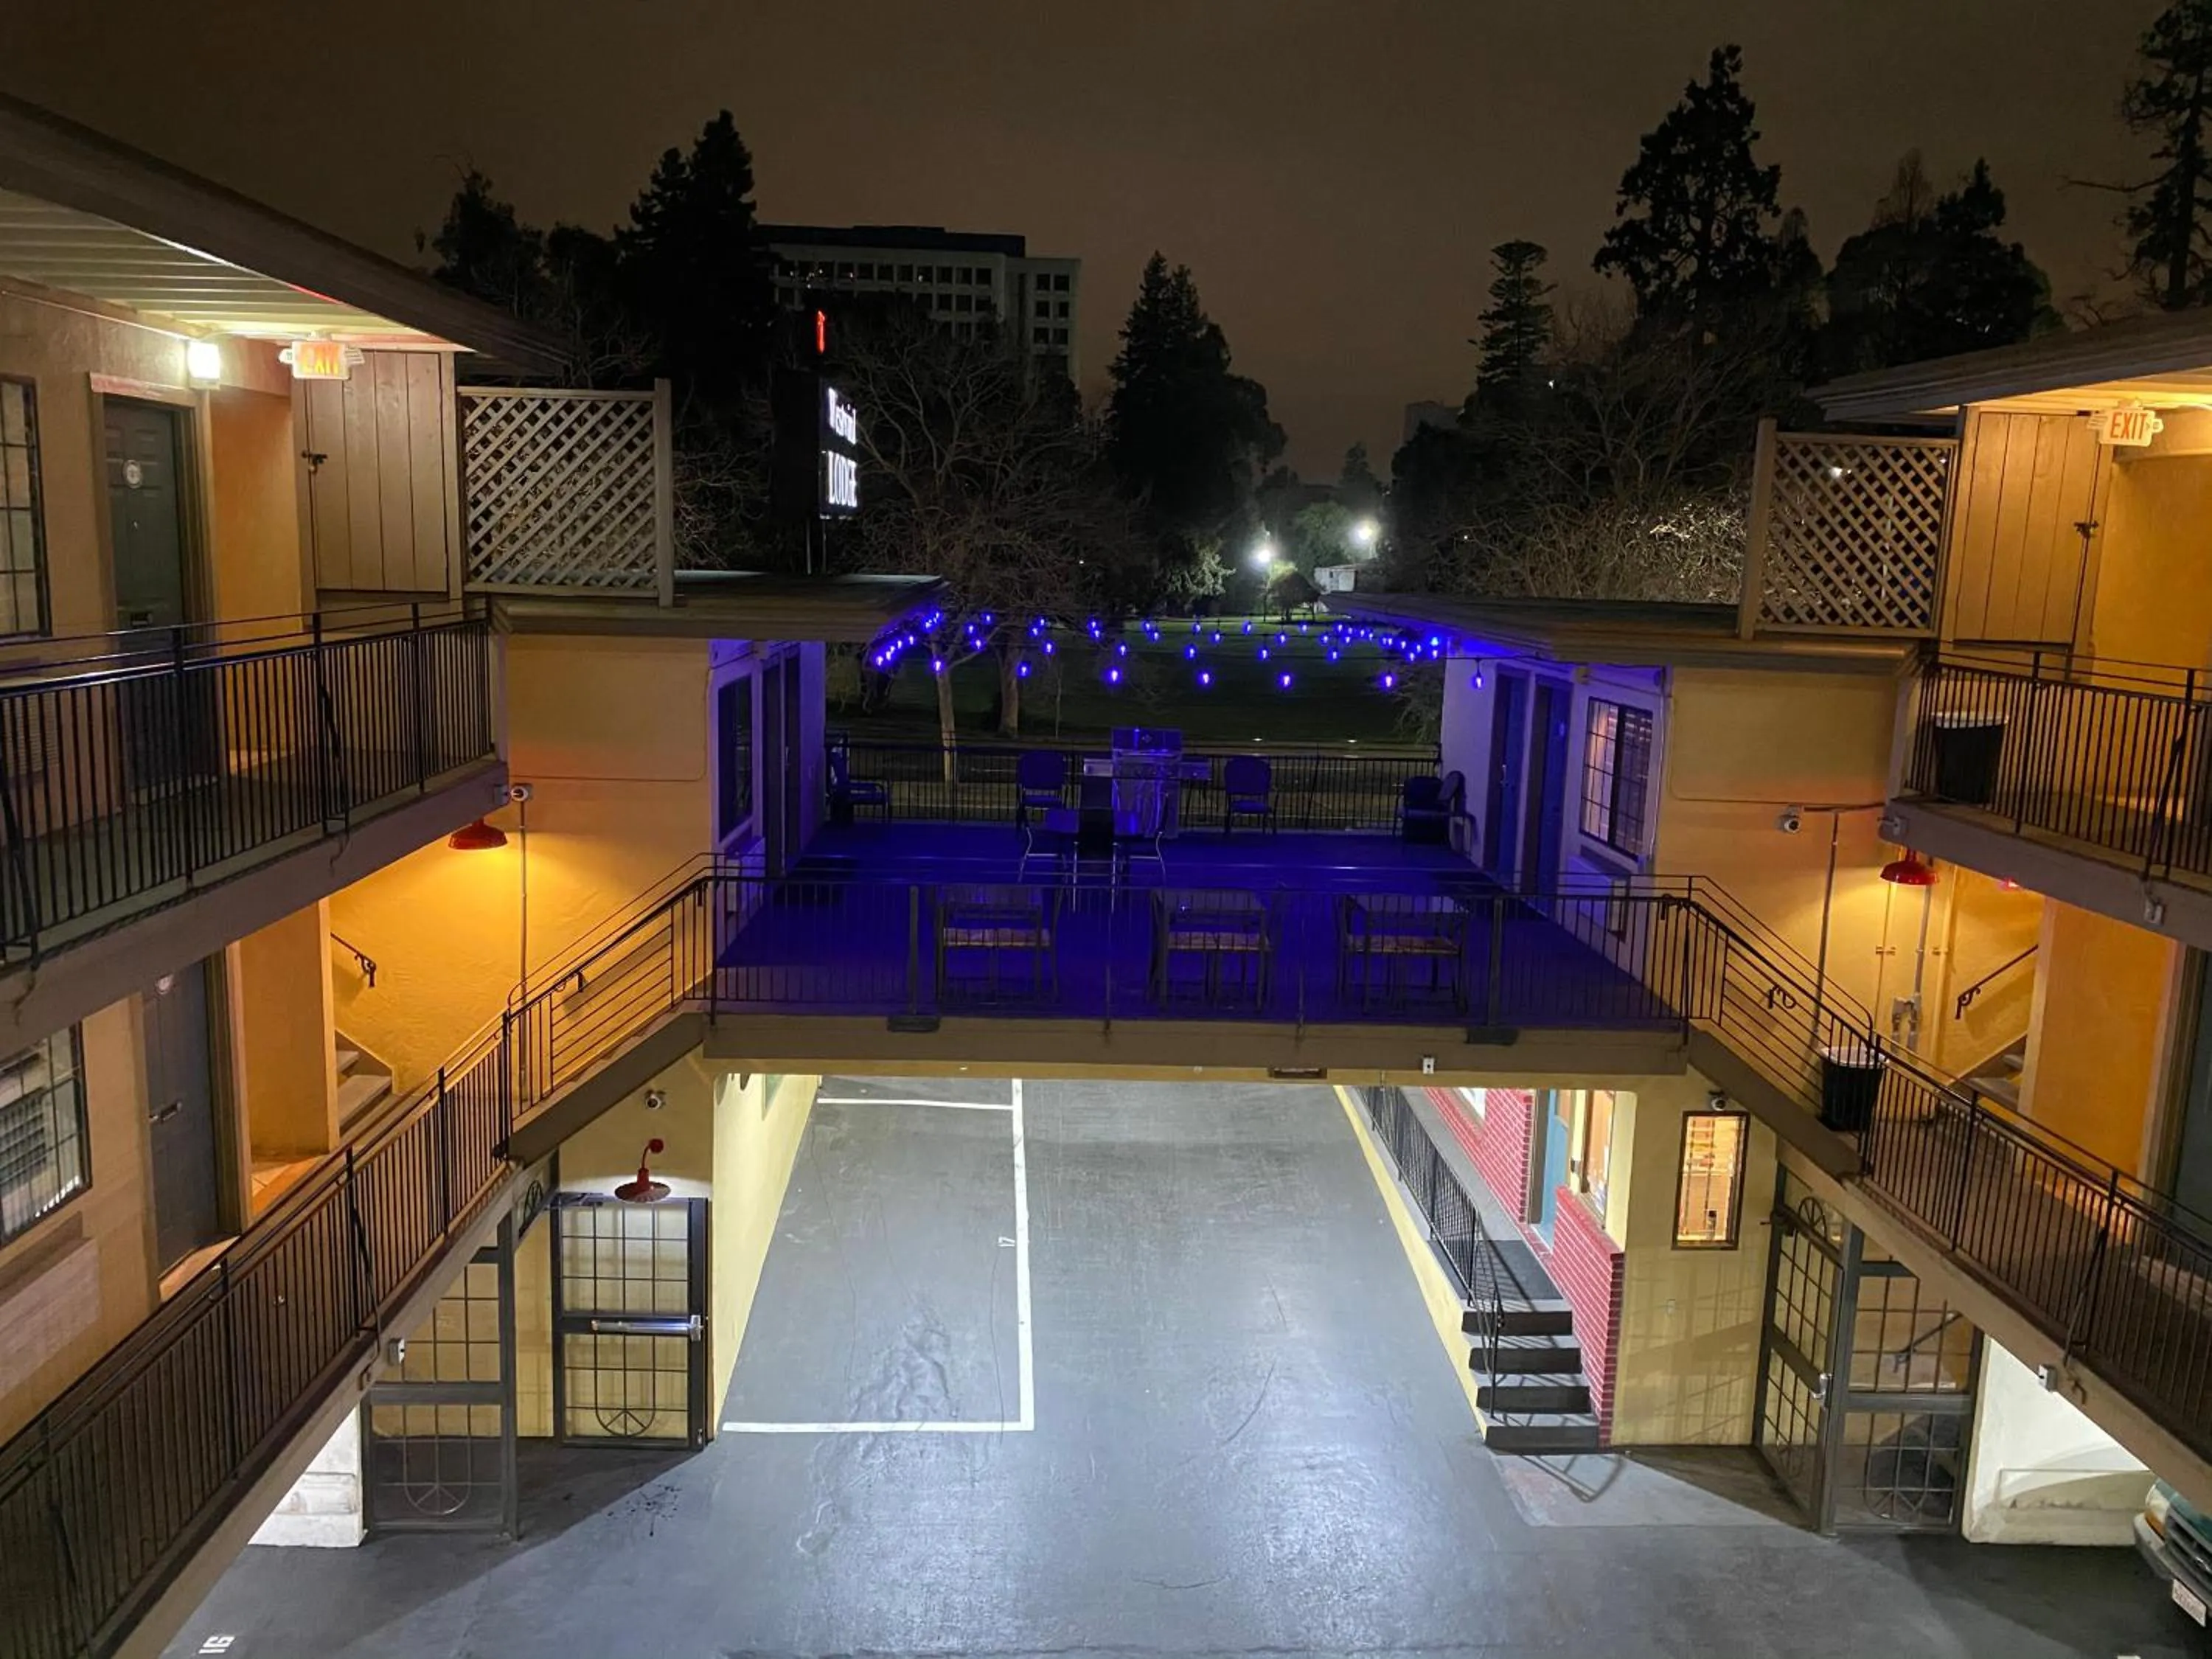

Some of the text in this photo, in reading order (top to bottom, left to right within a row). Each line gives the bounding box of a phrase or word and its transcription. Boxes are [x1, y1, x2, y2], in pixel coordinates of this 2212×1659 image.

[2110, 411, 2149, 440] EXIT
[827, 450, 858, 507] LODGE
[998, 1237, 1015, 1248] 17
